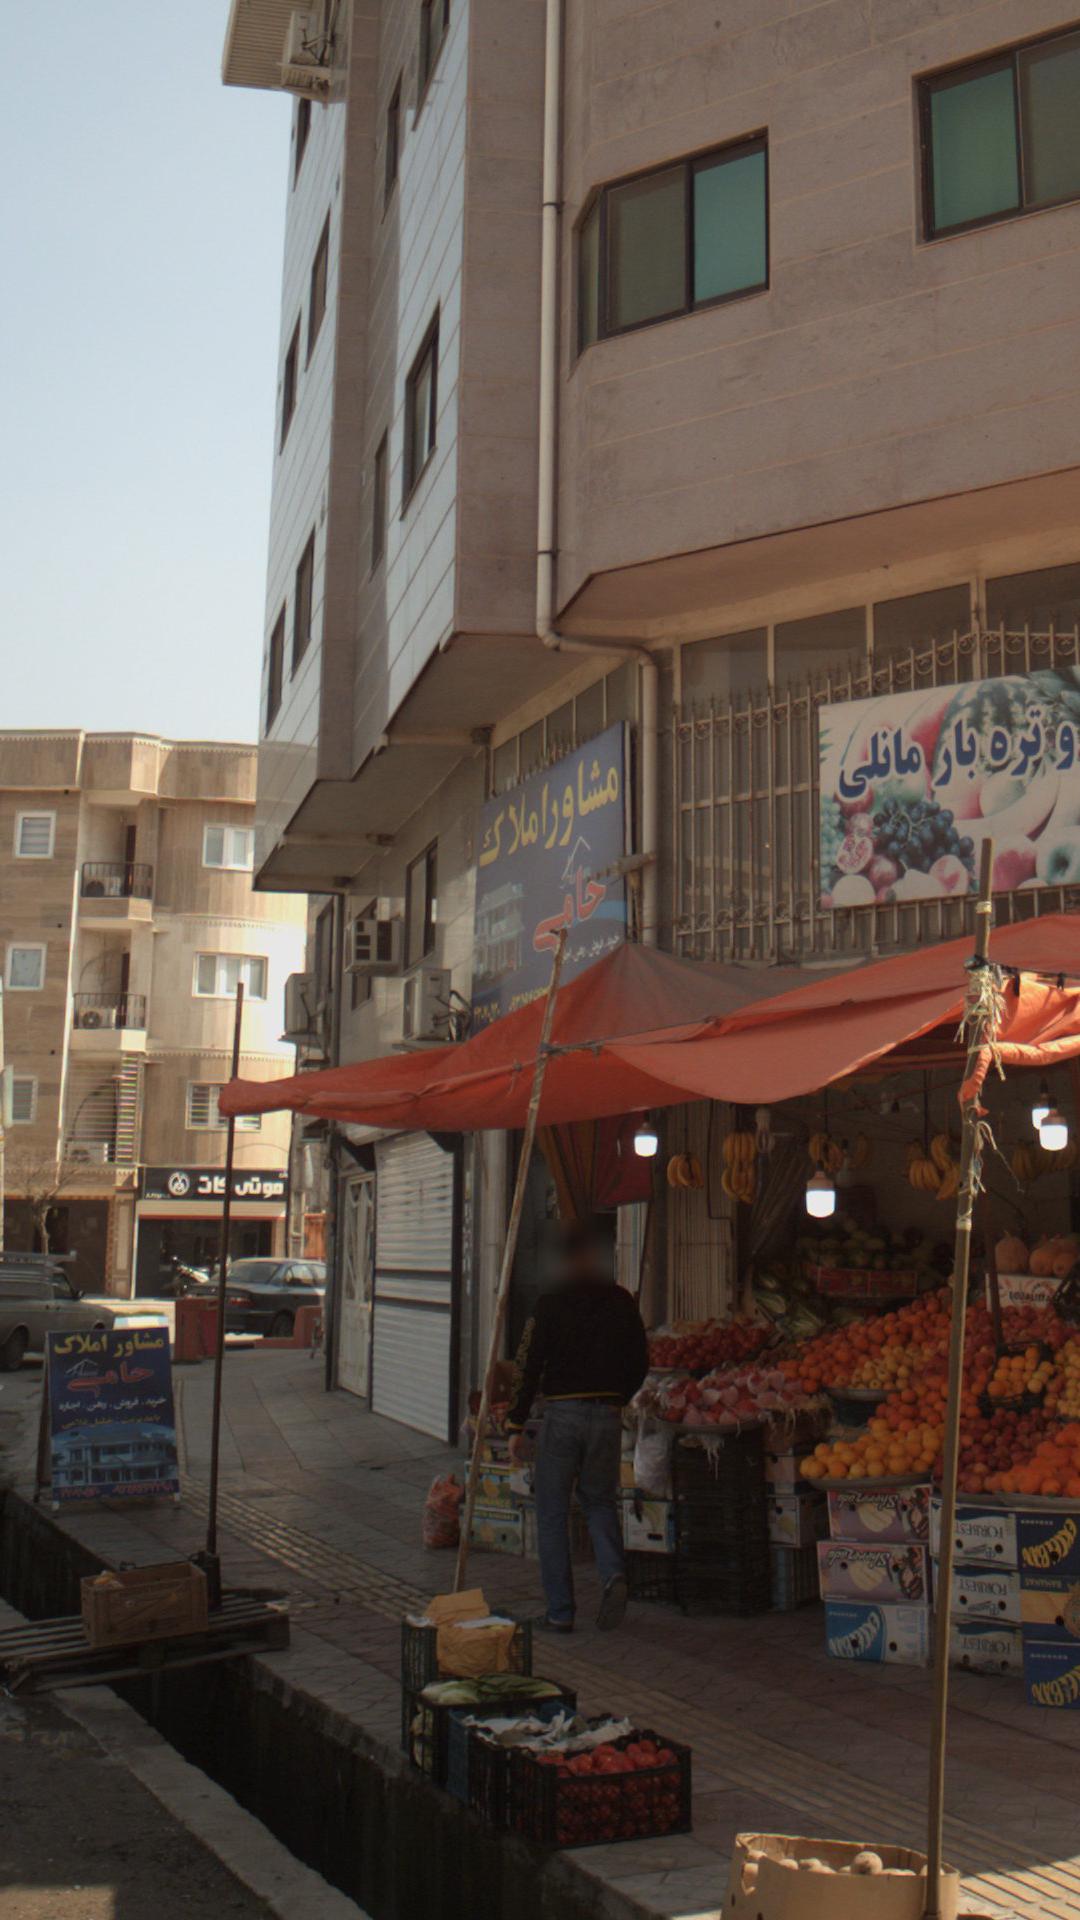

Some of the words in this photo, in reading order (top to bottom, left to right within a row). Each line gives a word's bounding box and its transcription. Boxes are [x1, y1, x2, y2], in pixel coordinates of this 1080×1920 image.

[839, 727, 921, 799] مانلی
[935, 720, 976, 786] بار
[991, 708, 1042, 777] تره
[1056, 725, 1074, 770] و
[479, 783, 549, 868] املاک
[545, 760, 619, 850] مشاور
[54, 1334, 107, 1355] املاک
[113, 1333, 164, 1357] مشاور
